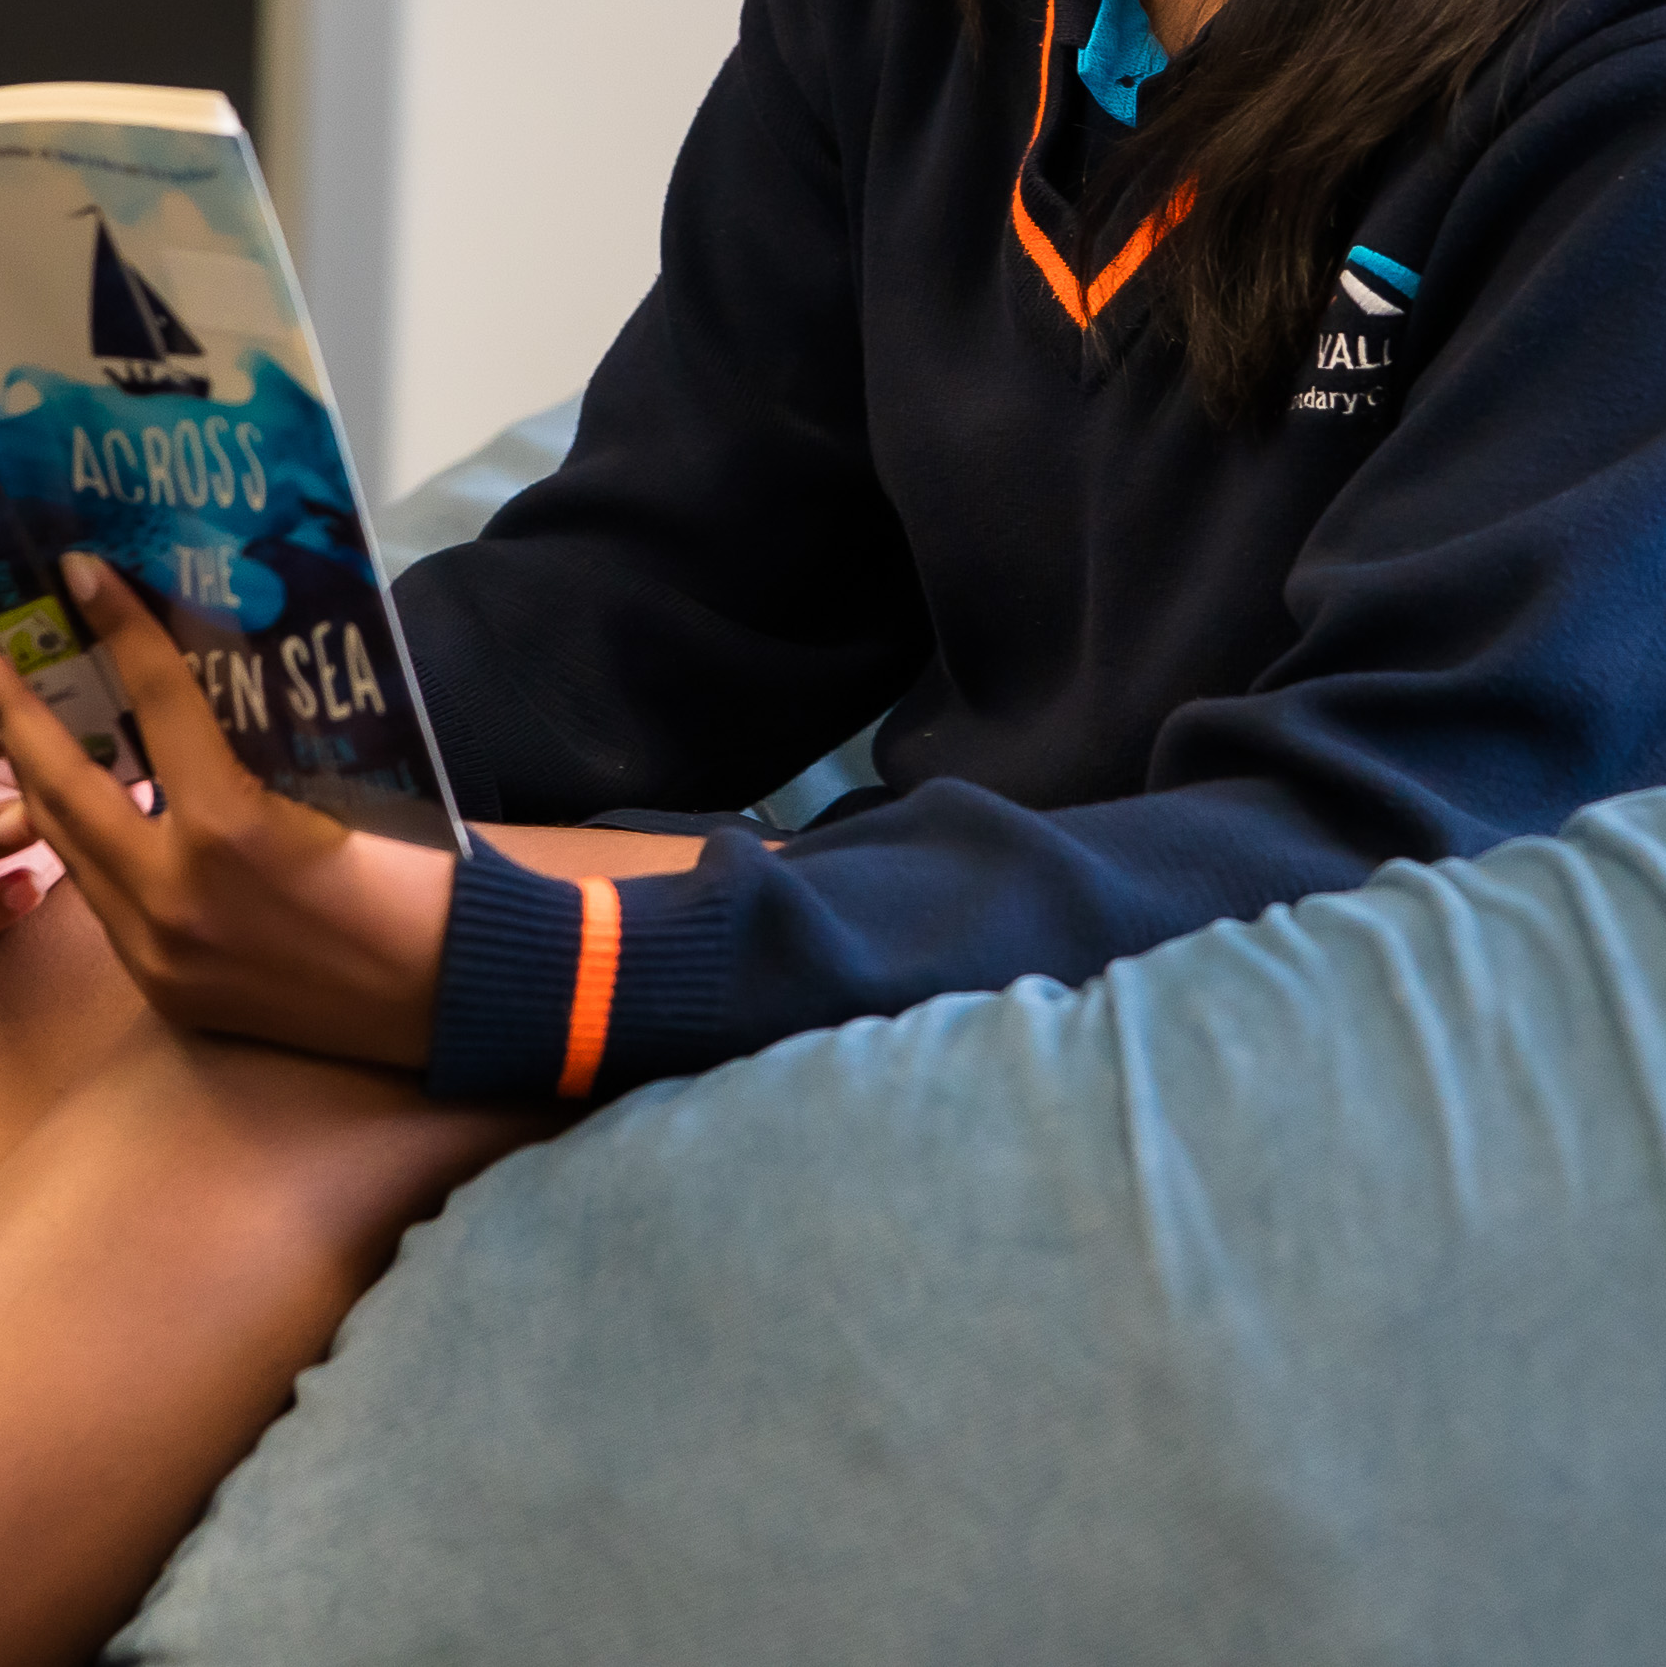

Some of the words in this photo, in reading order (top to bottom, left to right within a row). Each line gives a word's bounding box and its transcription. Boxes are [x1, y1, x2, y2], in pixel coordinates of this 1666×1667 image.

[71, 415, 268, 513] ACROSS
[172, 543, 242, 609] THE
[279, 619, 387, 721] SEA
